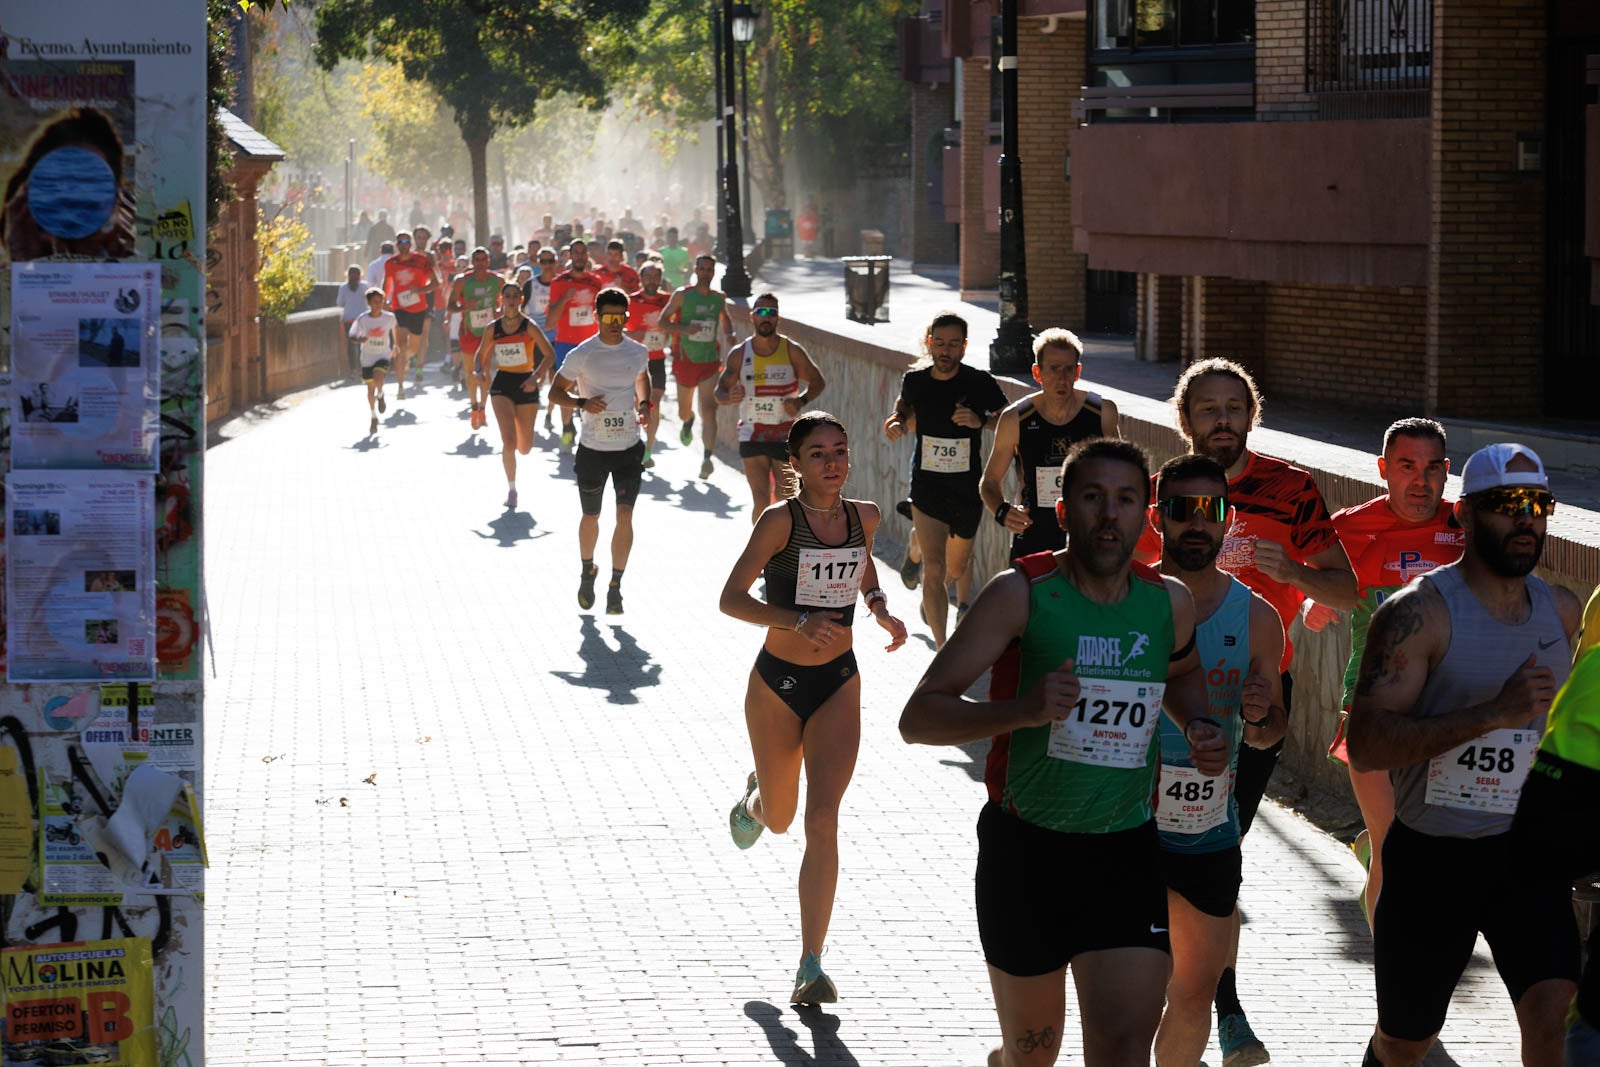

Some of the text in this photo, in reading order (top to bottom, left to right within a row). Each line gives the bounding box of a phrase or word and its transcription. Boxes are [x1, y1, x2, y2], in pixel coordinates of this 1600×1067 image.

[20, 38, 192, 57] Excmo. Ayuntamiento
[499, 348, 521, 358] 1064
[755, 403, 774, 412] 542
[604, 417, 625, 428] 939
[932, 445, 957, 457] 736
[811, 561, 859, 580] 1177
[1075, 635, 1122, 667] ATARFE
[1075, 666, 1152, 678] Atletismo Atarfe
[1074, 698, 1147, 728] 1270
[86, 730, 125, 742] OFERTA
[1092, 729, 1128, 740] ANTONIO
[1457, 745, 1515, 774] 458
[1475, 776, 1501, 786] SEBAS
[1165, 779, 1215, 802] 485
[44, 895, 109, 904] Mejoramos
[35, 949, 125, 963] AUTOESCUELAS
[9, 985, 45, 993] TODOS
[71, 979, 126, 988] PERMISOS
[86, 991, 134, 1044] B
[14, 1020, 77, 1035] PERMISO
